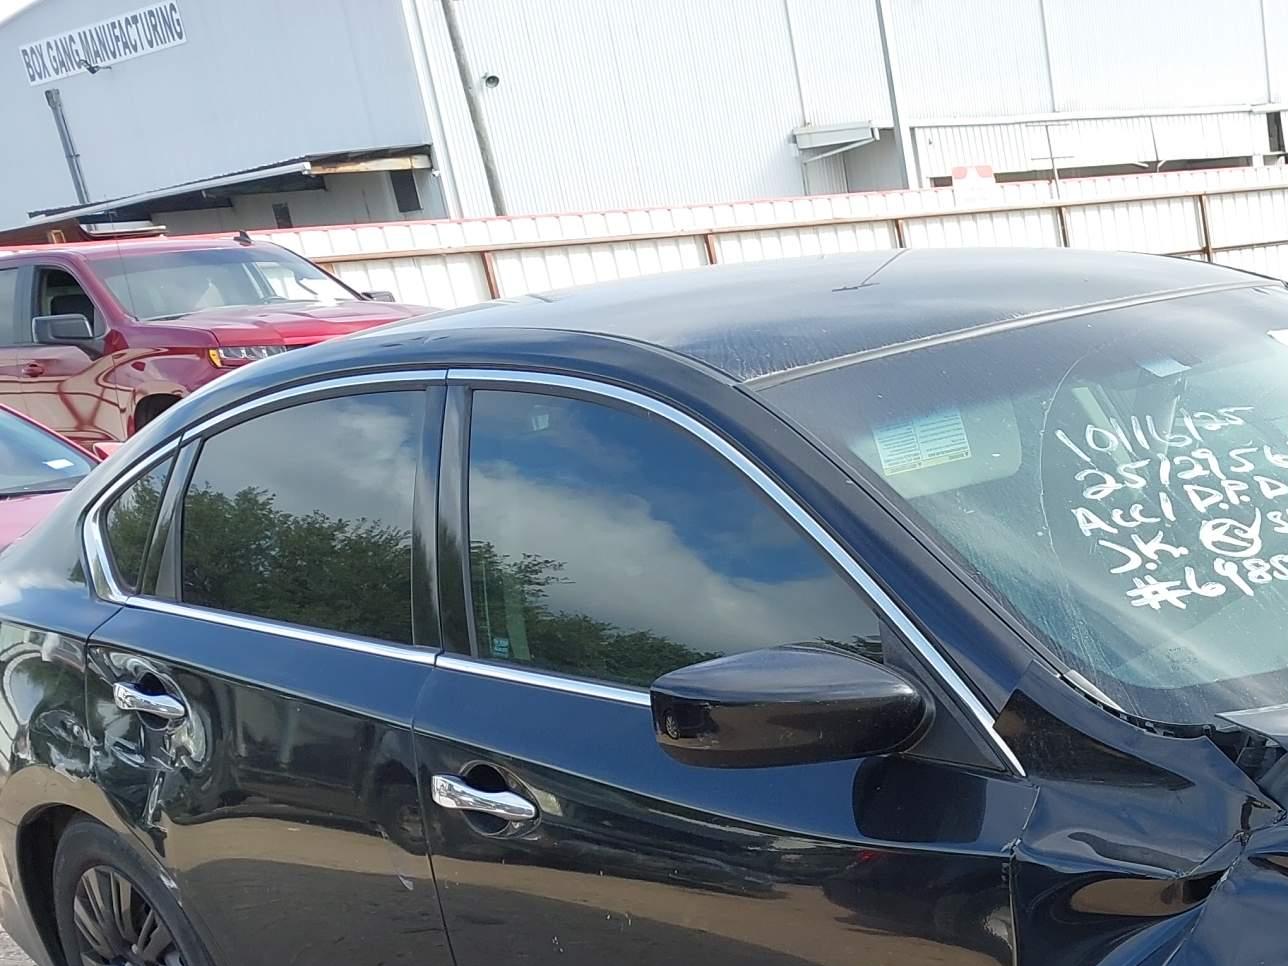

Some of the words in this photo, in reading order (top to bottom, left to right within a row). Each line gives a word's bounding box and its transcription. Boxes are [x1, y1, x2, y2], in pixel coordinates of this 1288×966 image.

[21, 44, 51, 82] BOX
[46, 34, 83, 75] GANG
[78, 3, 184, 64] MANUFACTURING
